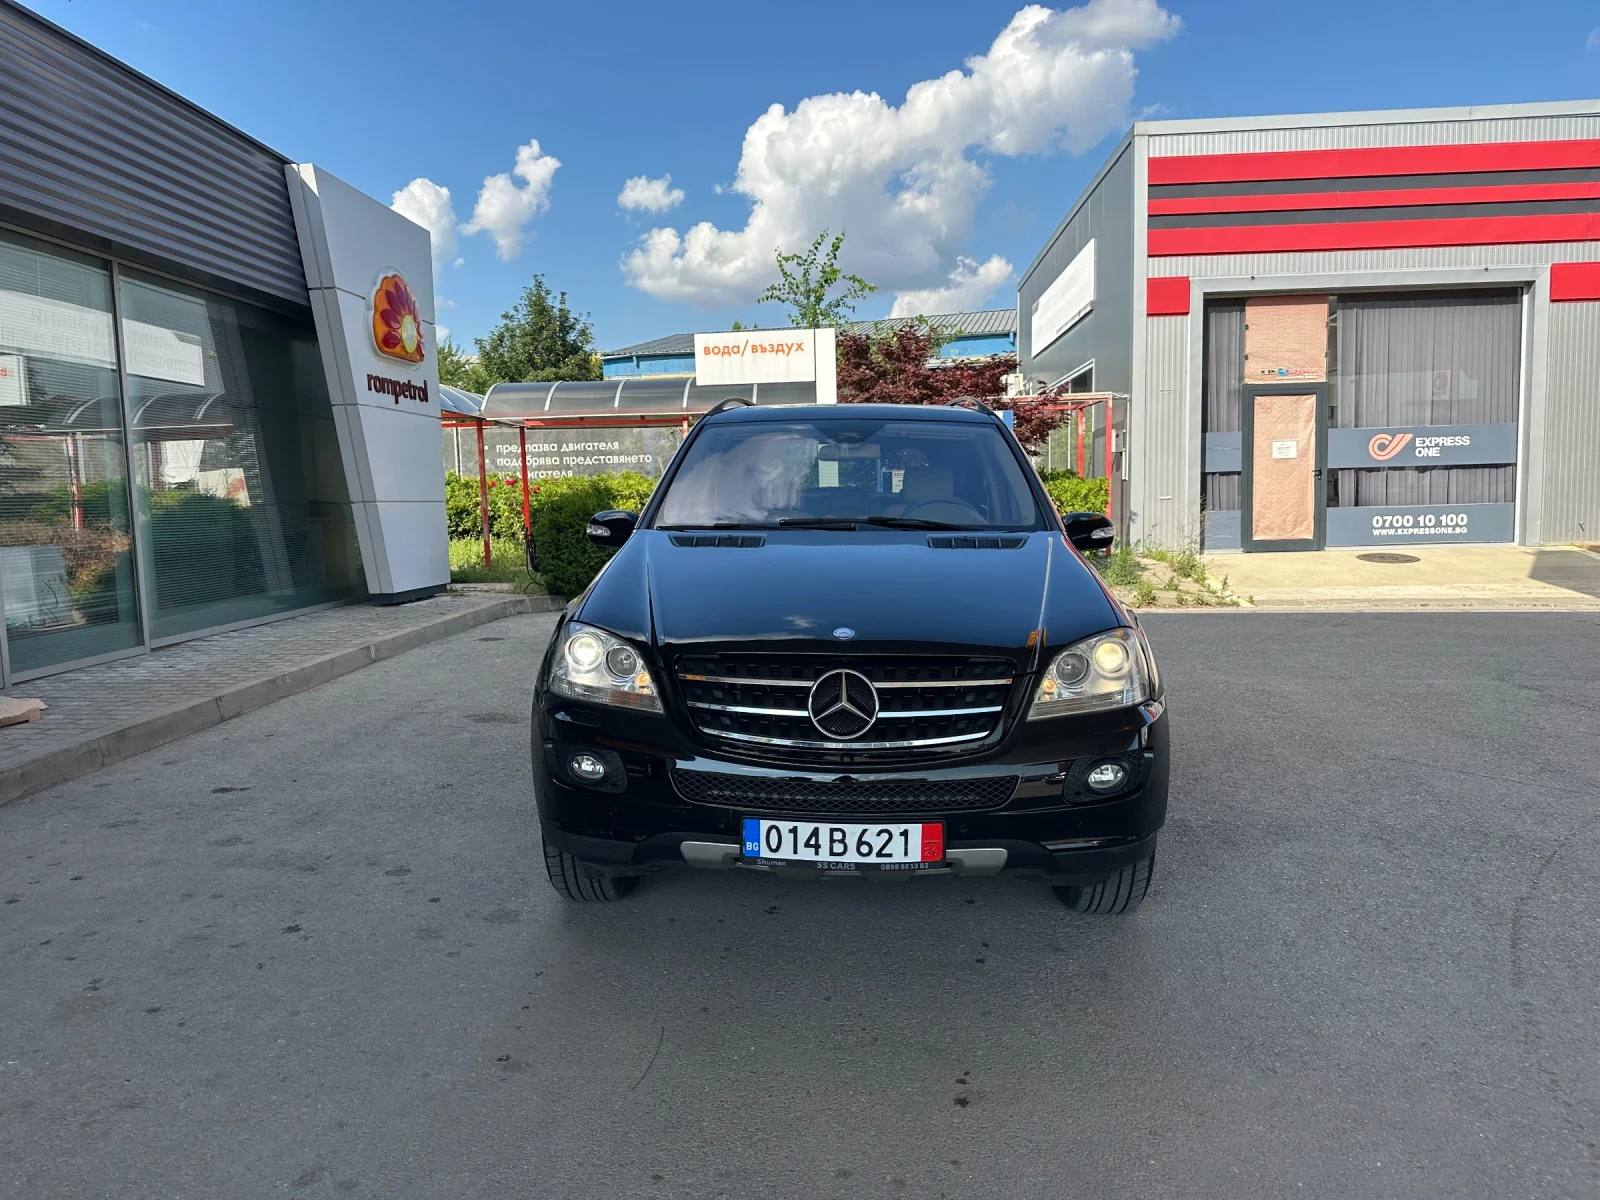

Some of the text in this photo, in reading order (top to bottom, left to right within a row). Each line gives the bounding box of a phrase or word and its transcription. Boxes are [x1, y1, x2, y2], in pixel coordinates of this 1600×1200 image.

[703, 339, 805, 357] вода/въздух
[366, 373, 429, 405] rompetrol
[560, 441, 619, 452] двигателя
[1415, 436, 1470, 447] EXPRESS
[1415, 447, 1440, 457] ONE
[563, 454, 652, 467] представянето
[1372, 513, 1468, 527] 0700 10 100
[1372, 527, 1468, 536] WWW.EXPRESSONE.BG
[746, 841, 759, 851] BG
[757, 858, 787, 867] Shumen
[816, 861, 856, 871] SS CARS
